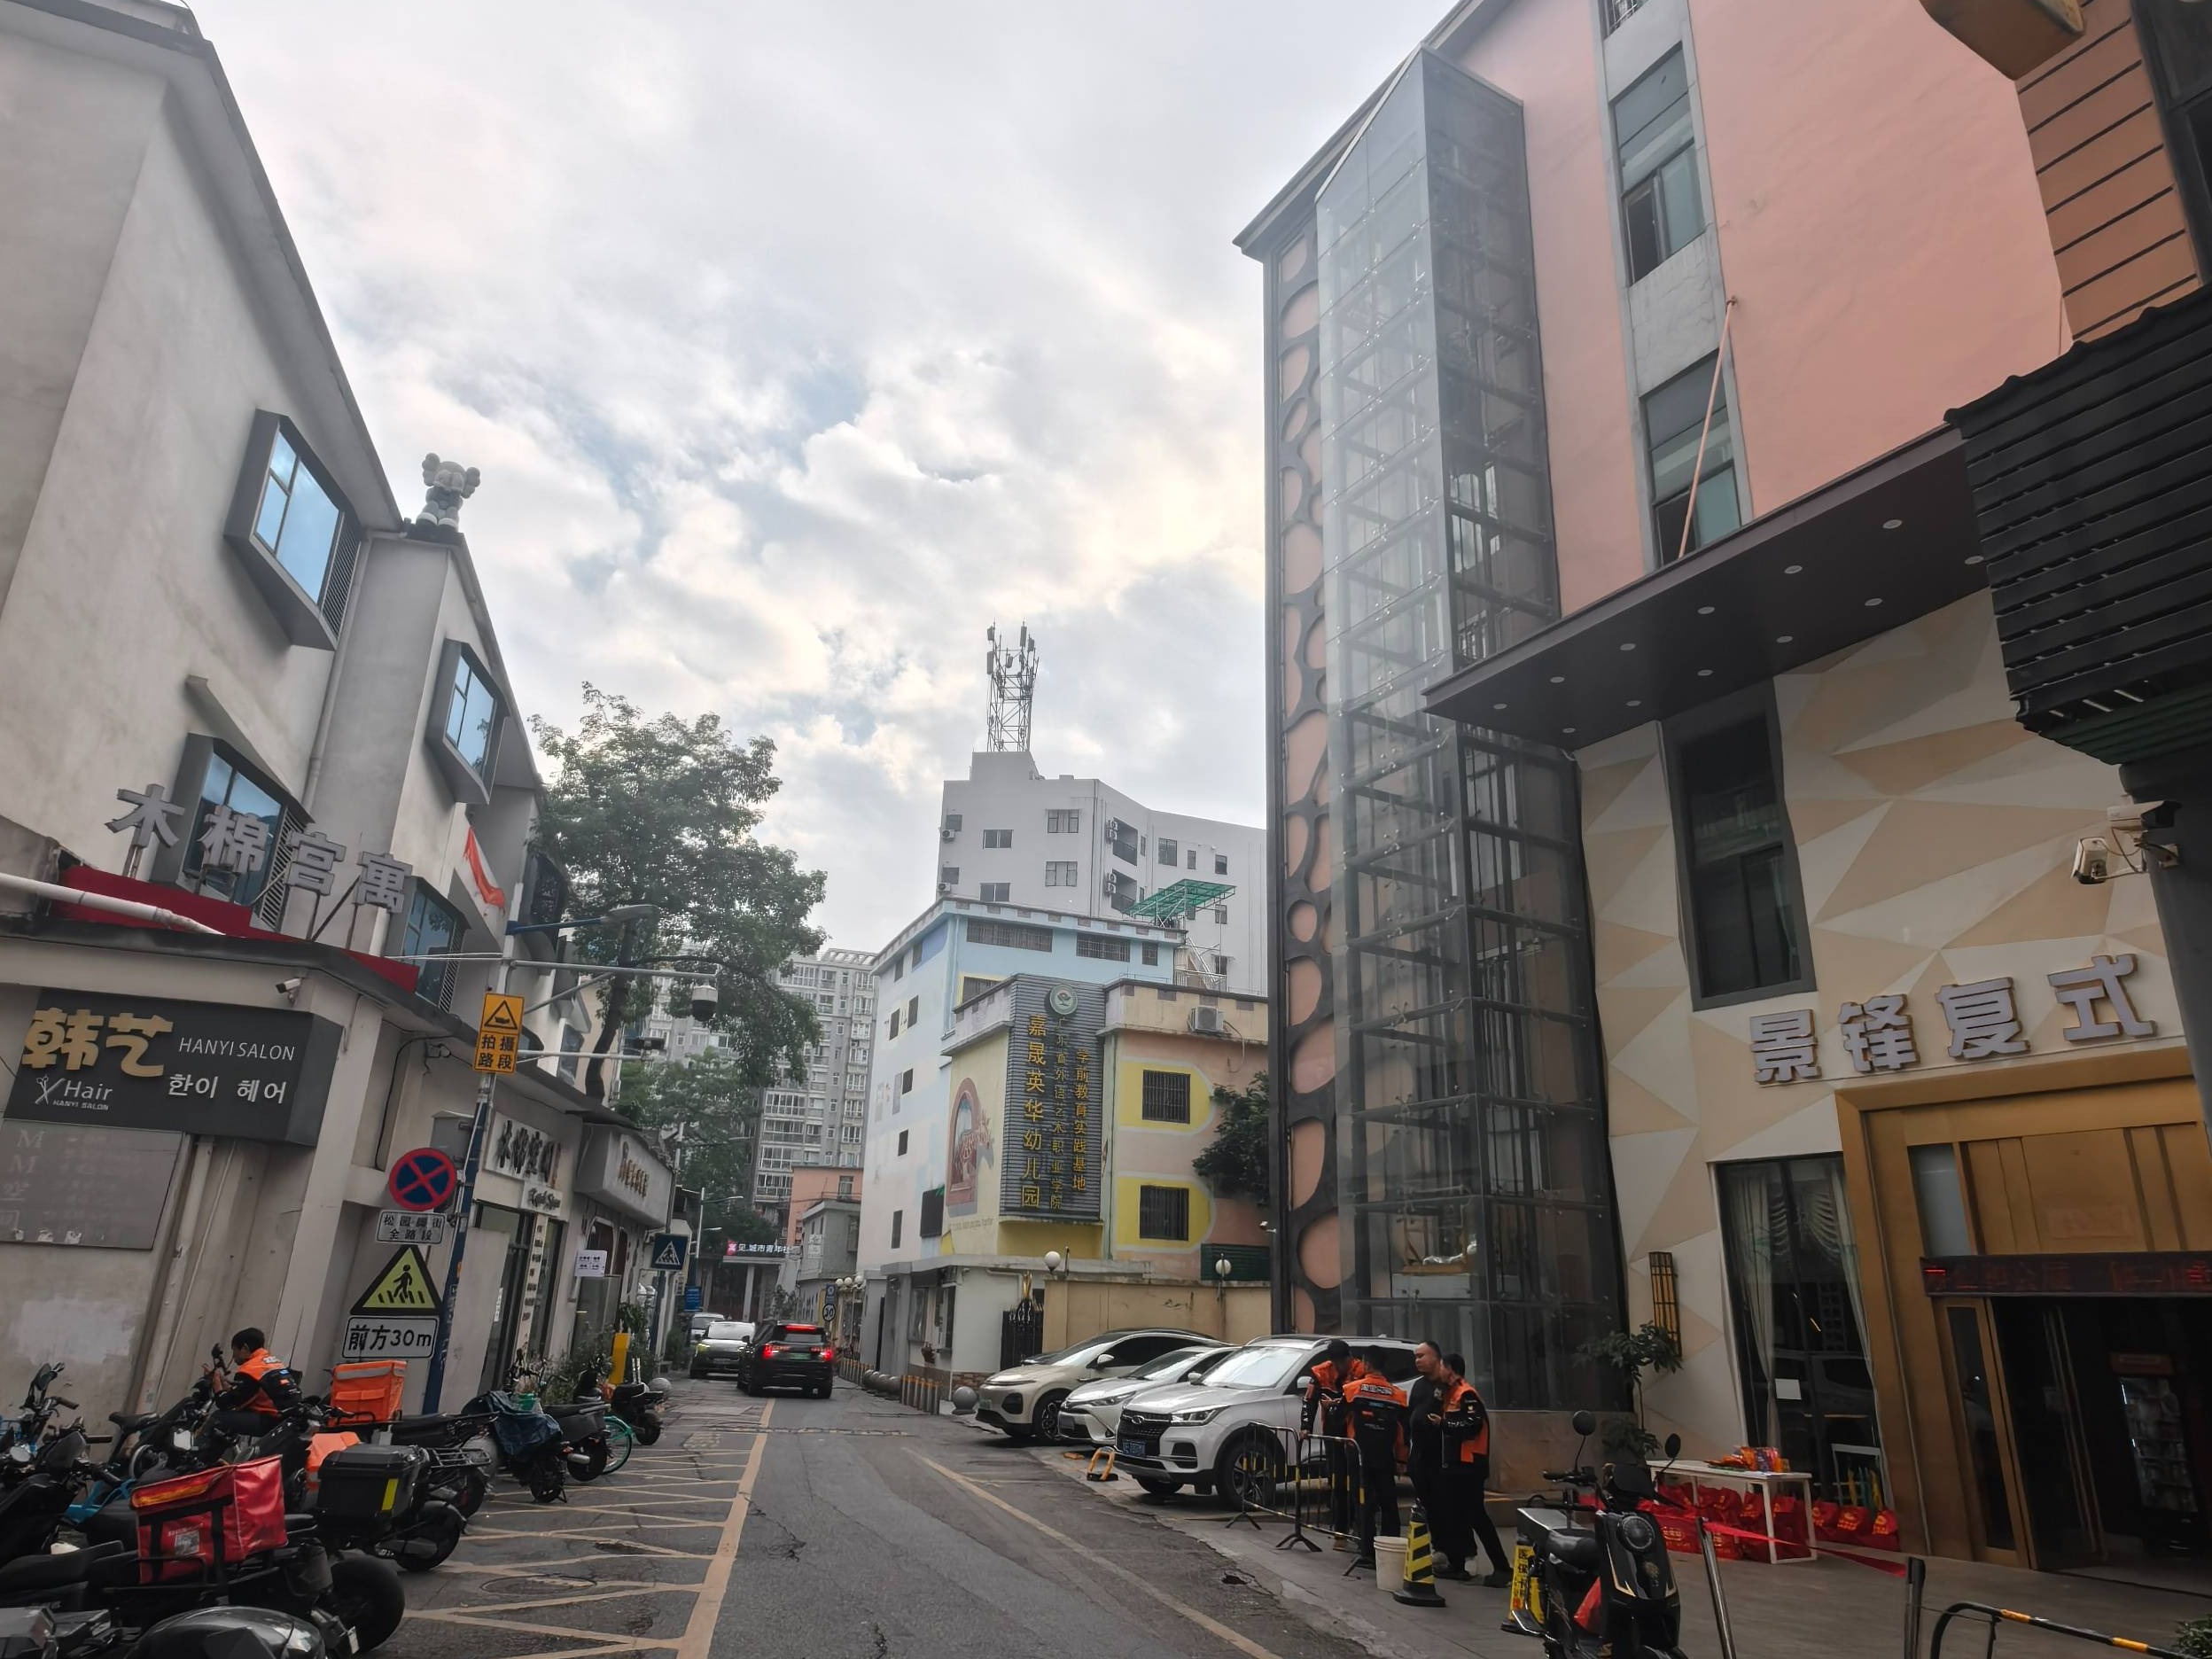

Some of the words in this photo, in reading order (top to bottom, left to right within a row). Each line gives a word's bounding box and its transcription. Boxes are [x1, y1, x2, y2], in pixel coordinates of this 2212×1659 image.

[1749, 954, 2157, 1084] 景锋复式
[21, 1007, 174, 1078] 韩艺
[179, 1037, 234, 1056] HANYI
[237, 1042, 295, 1062] SALON
[478, 1052, 512, 1069] 路段
[64, 1080, 113, 1101] Hair
[168, 1073, 219, 1099] 한이
[237, 1079, 287, 1104] 헤어
[1021, 1013, 1047, 1207] 嘉晟英华幼儿园
[1071, 1048, 1091, 1191] 学前教育实践基地
[389, 1228, 432, 1241] 全路段
[348, 1324, 432, 1351] 前方30m
